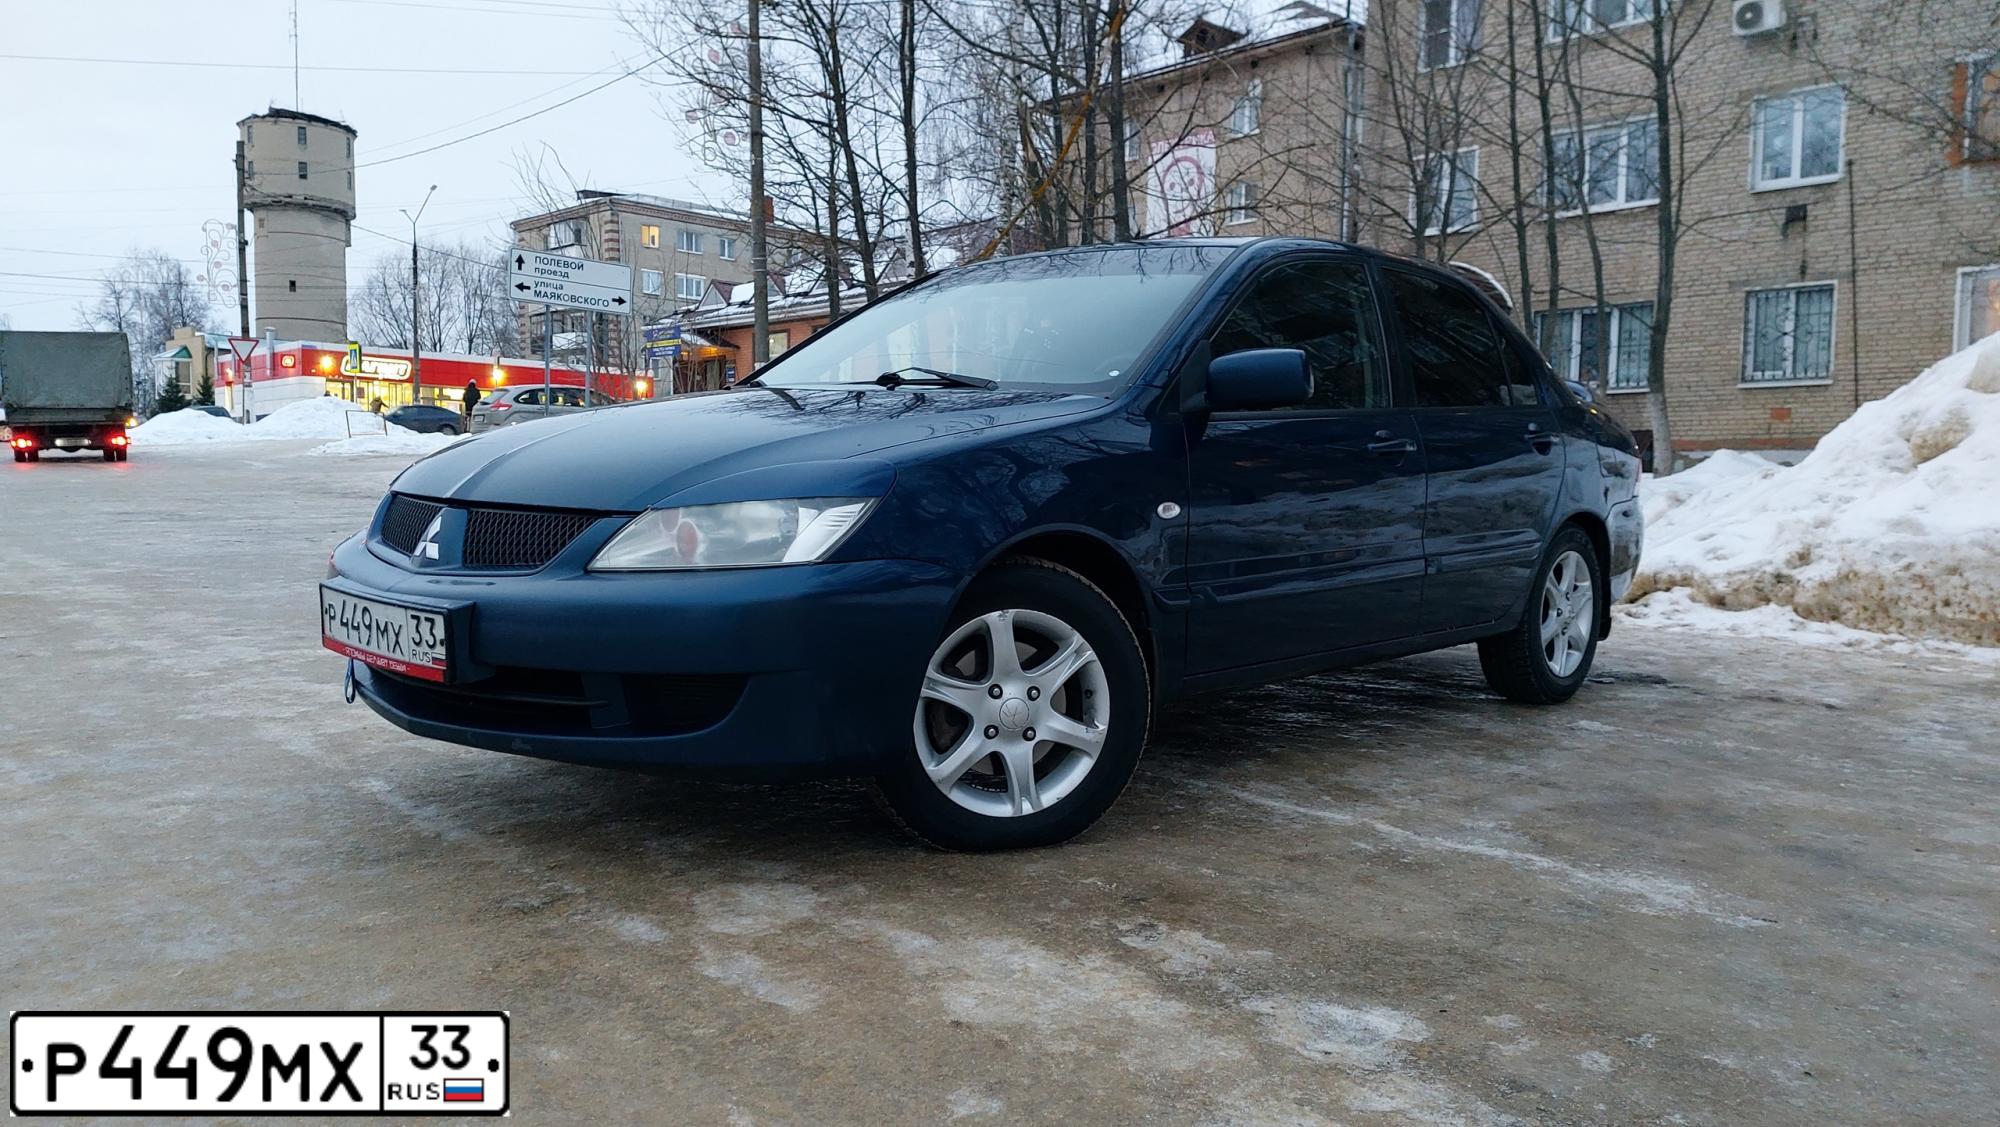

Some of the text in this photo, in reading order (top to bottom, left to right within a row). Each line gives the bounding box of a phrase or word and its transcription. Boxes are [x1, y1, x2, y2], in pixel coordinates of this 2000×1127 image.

[534, 255, 584, 271] ПОЛЕВОЙ
[534, 266, 569, 279] проезд
[533, 280, 564, 292] улица
[533, 289, 610, 308] МАЯКОВСКОГО
[410, 614, 437, 649] 33
[411, 649, 432, 663] RUS
